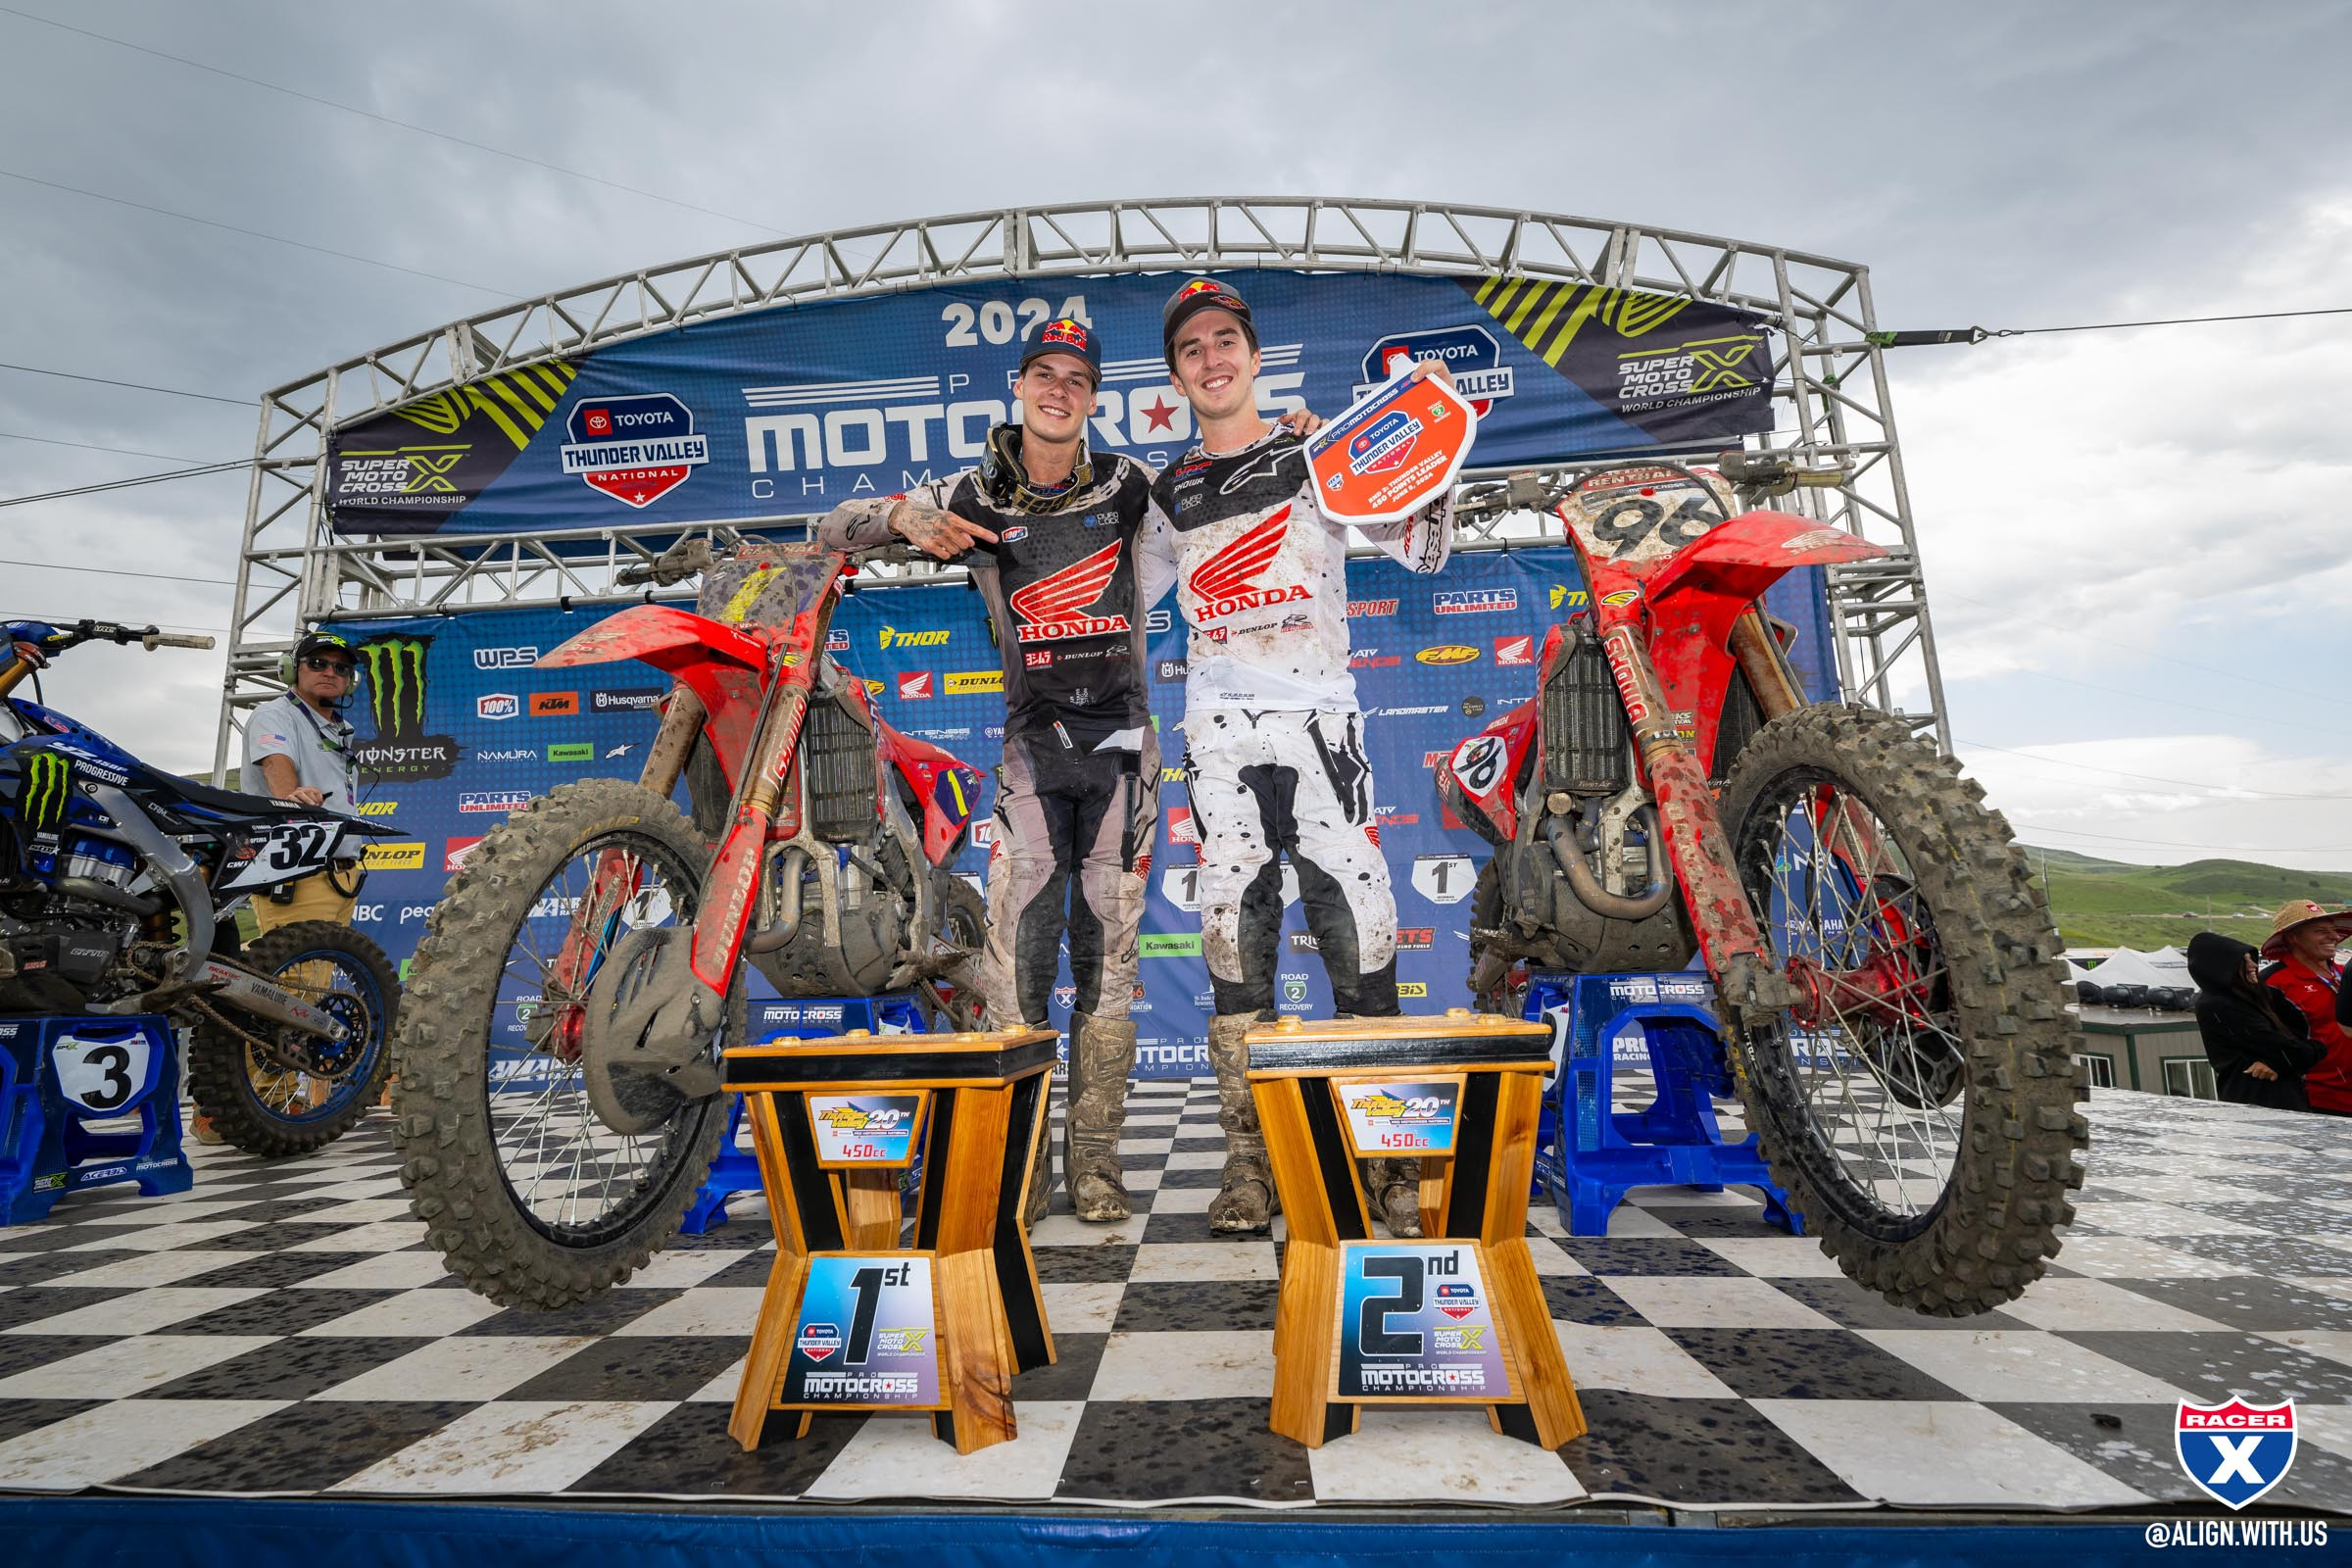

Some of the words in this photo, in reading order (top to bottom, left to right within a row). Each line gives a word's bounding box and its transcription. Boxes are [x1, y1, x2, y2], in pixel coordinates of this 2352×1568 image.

[942, 296, 1092, 347] 2024
[1043, 332, 1065, 343] Red
[1065, 333, 1086, 351] Bull
[1414, 344, 1479, 363] TOYOTA
[1618, 356, 1695, 374] SUPER
[1456, 373, 1509, 395] ALLEY
[1624, 368, 1691, 385] MOTO
[1619, 379, 1694, 399] CROSS
[1622, 400, 1664, 413] WORLD
[1666, 387, 1761, 407] CHAMPIONSHIP
[614, 411, 674, 426] TOYOTA
[745, 371, 1308, 473] MOTOROS
[1370, 418, 1399, 439] TOYOTA
[564, 445, 641, 467] THUNDER
[643, 440, 705, 462] VALLEY
[1352, 443, 1390, 471] THUNDER
[1390, 421, 1421, 445] VALLEY
[1372, 441, 1411, 468] NATIONAL
[340, 460, 410, 470] SUPER
[1388, 466, 1419, 487] THUNDER
[1418, 450, 1443, 466] VALLEY
[345, 470, 407, 481] MOTO
[598, 469, 678, 481] NATIONAL
[1372, 495, 1388, 509] 450
[1388, 474, 1416, 497] POINTS
[1416, 455, 1447, 477] LEADER
[1588, 470, 1676, 487] RENTHAL
[339, 481, 408, 493] CROSS
[1392, 488, 1408, 502] JUNE
[1416, 472, 1434, 486] 2024
[381, 495, 466, 505] CHAMPIONSHIP
[1004, 527, 1028, 539] 100%
[1592, 494, 1725, 560] 96
[1194, 584, 1313, 622] HONDA
[1435, 589, 1517, 607] PARTS
[1435, 602, 1517, 614] UNLIMITED
[1017, 615, 1131, 643] HONDA
[1238, 623, 1278, 635] DUNLOP
[895, 630, 951, 647] THOR
[475, 647, 538, 668] WPS
[1065, 651, 1103, 660] DUNLOP
[1417, 647, 1480, 663] FMF
[483, 699, 514, 714] 100%
[538, 698, 570, 710] KTM
[608, 695, 659, 707] Husqvarna
[1378, 706, 1449, 716] LANDMASTER
[354, 746, 448, 764] MONSTER
[477, 749, 538, 760] NAMURA
[552, 748, 589, 758] Kawasaki
[74, 760, 129, 786] PROGRESSIVE
[361, 765, 430, 774] ENERGY
[460, 792, 531, 805] PARTS
[948, 768, 969, 817] 1
[269, 800, 302, 809] YAMAHA
[460, 803, 529, 812] UNLIMITED
[270, 825, 328, 870] 32
[366, 850, 421, 860] NLOP
[711, 847, 756, 974] DUNLOP
[1146, 940, 1196, 951] Kawasaki
[250, 982, 289, 1005] YAMALUBE
[1291, 987, 1300, 998] 2
[1609, 984, 1705, 997] MOTOCROSS
[763, 1010, 842, 1020] MOTOCROSS
[80, 1045, 132, 1108] 3
[1381, 1133, 1429, 1148] 450cc
[843, 1144, 887, 1157] 450cc
[136, 1158, 178, 1171] MOTOCROSS
[1359, 1250, 1459, 1356] 2nd
[844, 1261, 911, 1365] 1st
[804, 1378, 918, 1393] MOTOCROSS
[1360, 1369, 1486, 1386] MOTOCROSS
